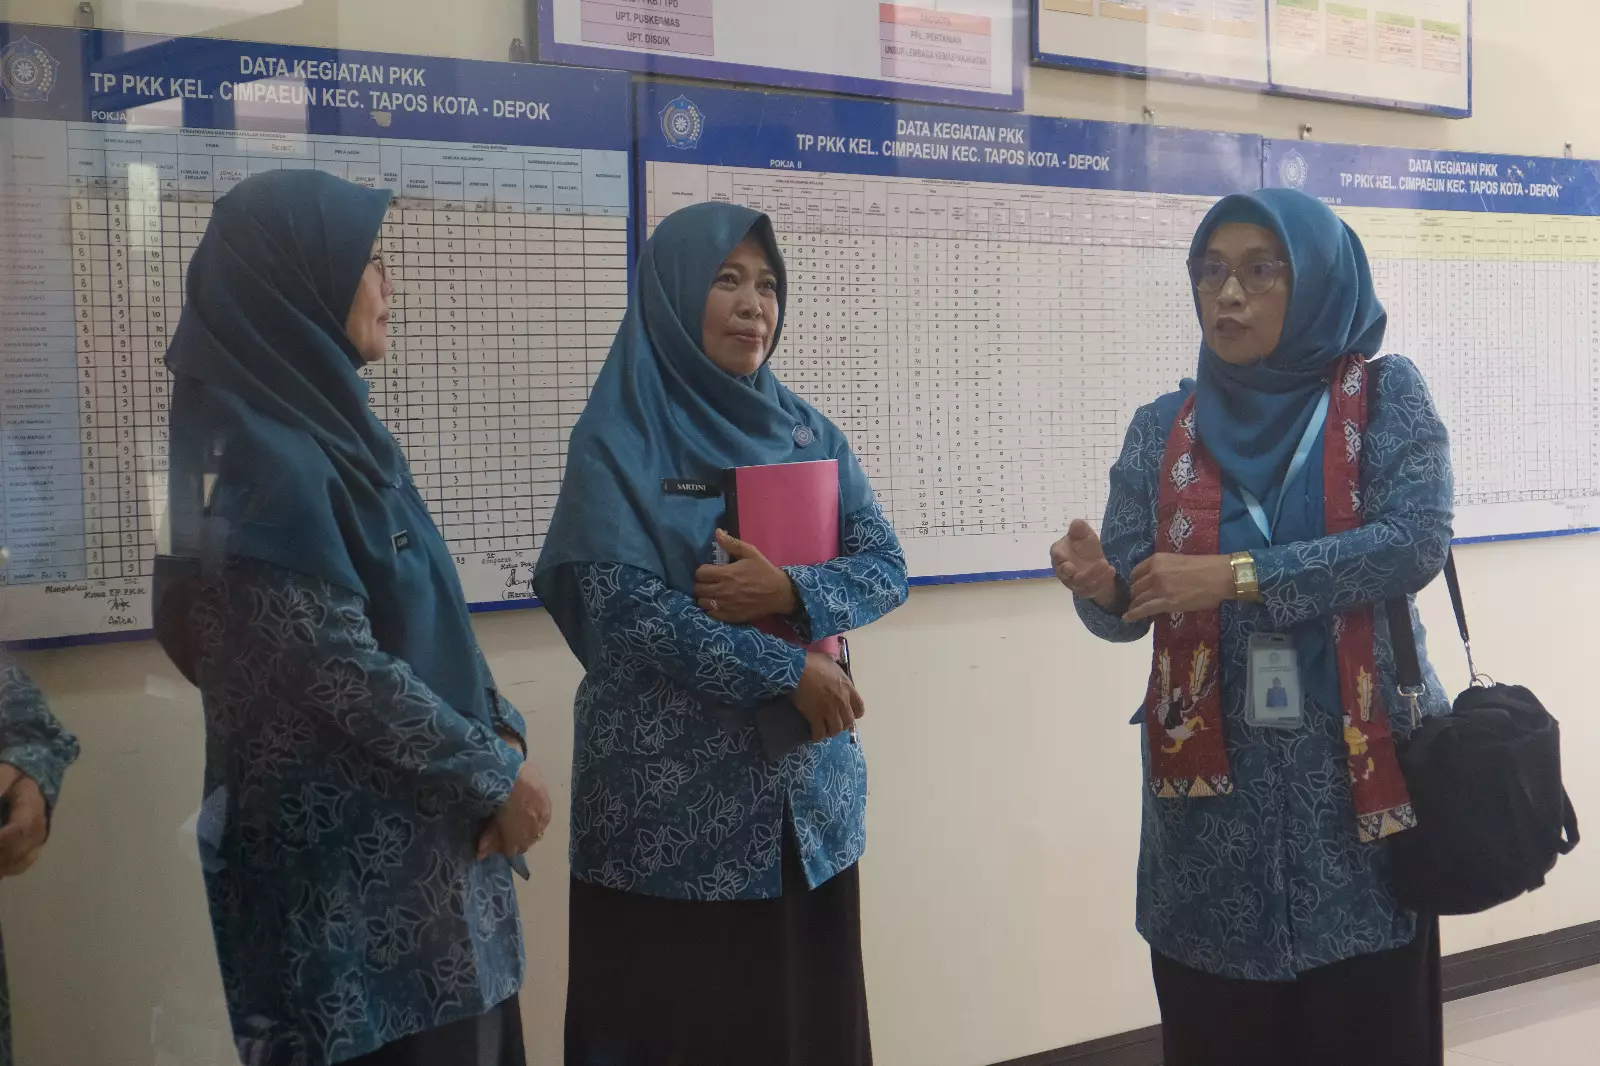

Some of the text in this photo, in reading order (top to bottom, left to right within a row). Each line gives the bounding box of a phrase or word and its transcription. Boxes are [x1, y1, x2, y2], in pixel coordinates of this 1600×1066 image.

[616, 11, 680, 28] UPT. PUSKESMAS
[627, 32, 670, 46] UPT. DISDIK
[926, 33, 961, 45] PERTANIAN
[906, 48, 934, 59] LEMBAGA
[240, 56, 426, 87] DATA KEGIATAN PKK
[90, 72, 116, 92] TP
[122, 76, 165, 96] PKK
[170, 78, 213, 99] KEL.
[220, 82, 316, 106] CIMPAEUN
[322, 88, 364, 109] KEC.
[370, 91, 428, 113] TAPOS
[433, 96, 479, 116] KOTA
[493, 100, 550, 121] DEPOK
[91, 111, 126, 122] POKJA
[897, 119, 1024, 144] DATA KEGIATAN PKK
[797, 134, 814, 151] TP
[818, 136, 845, 153] PKK
[849, 138, 879, 156] KEL.
[882, 140, 949, 160] CIMPAEUN
[952, 145, 981, 163] KEC.
[984, 147, 1024, 166] TAPOS
[1028, 151, 1059, 168] KOTA
[1069, 154, 1110, 172] DEPOK
[770, 159, 794, 169] POKJA
[1408, 159, 1497, 177] DATA KEGIATAN PKK
[1340, 173, 1353, 187] TP
[1354, 174, 1375, 188] PKK
[1376, 175, 1397, 189] KEL.
[1399, 177, 1445, 192] CIMPAEUN
[1447, 179, 1467, 193] KEC.
[1470, 180, 1499, 195] TAPOS
[1500, 182, 1523, 196] KOTA
[1529, 184, 1560, 198] DEPOK
[677, 483, 706, 492] SARTINI
